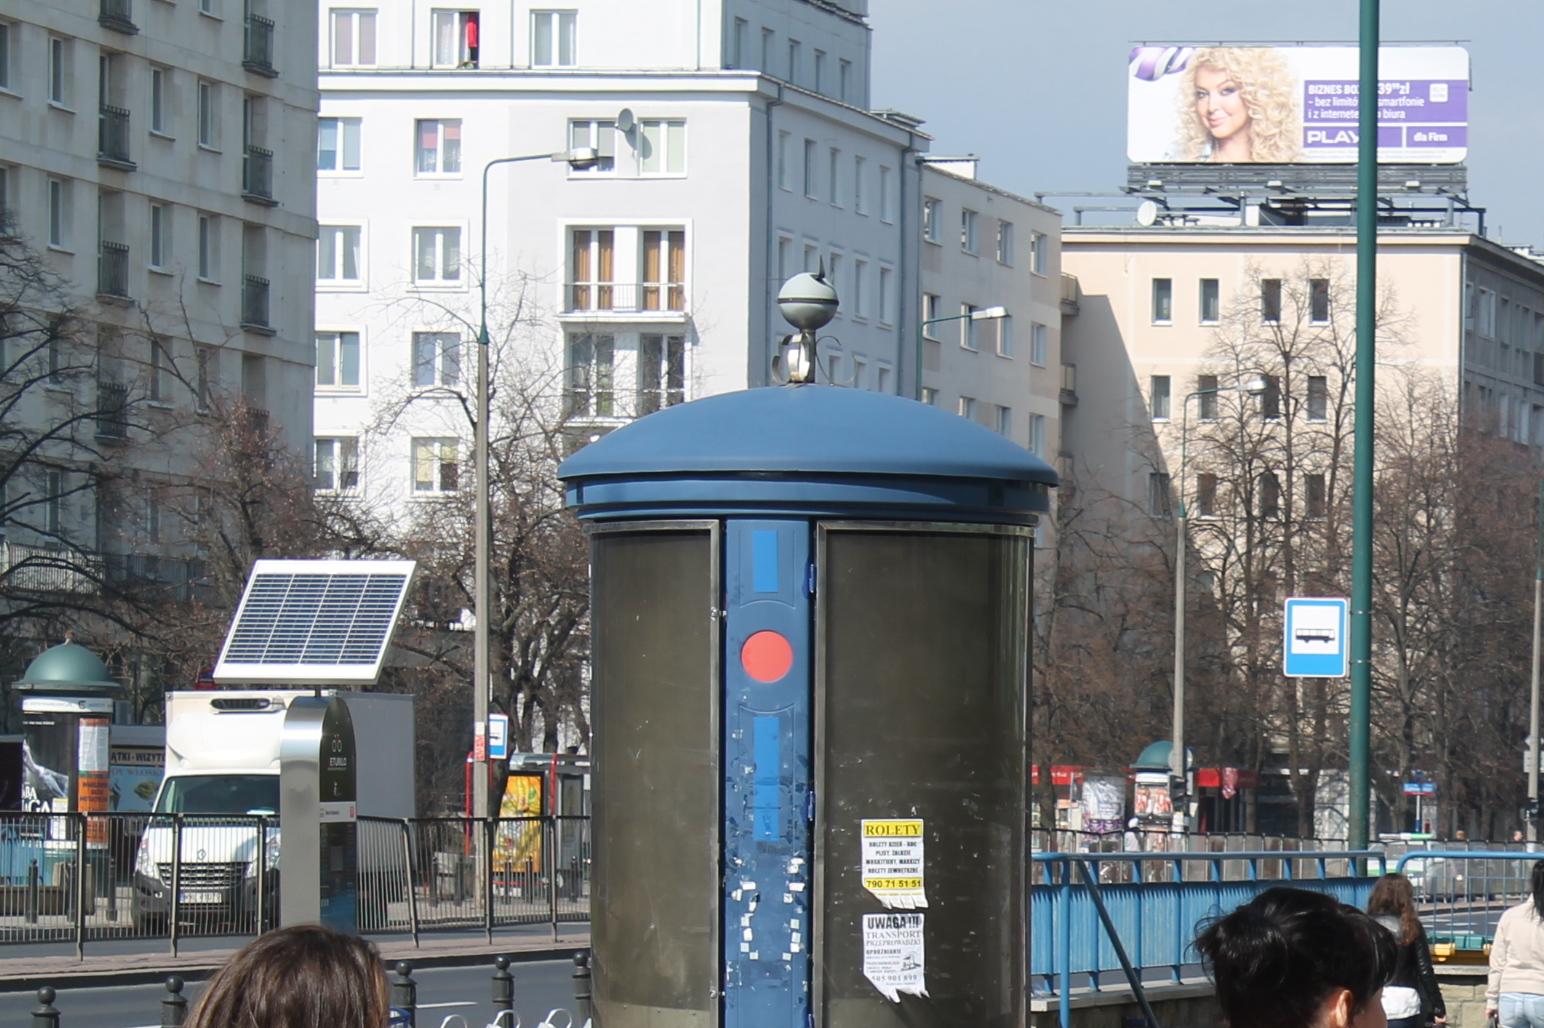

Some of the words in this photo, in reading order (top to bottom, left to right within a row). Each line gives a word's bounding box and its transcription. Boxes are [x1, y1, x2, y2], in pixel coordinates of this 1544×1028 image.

[1308, 84, 1341, 95] BIZNES
[1333, 96, 1359, 107] limitó
[865, 824, 921, 836] ROLETY
